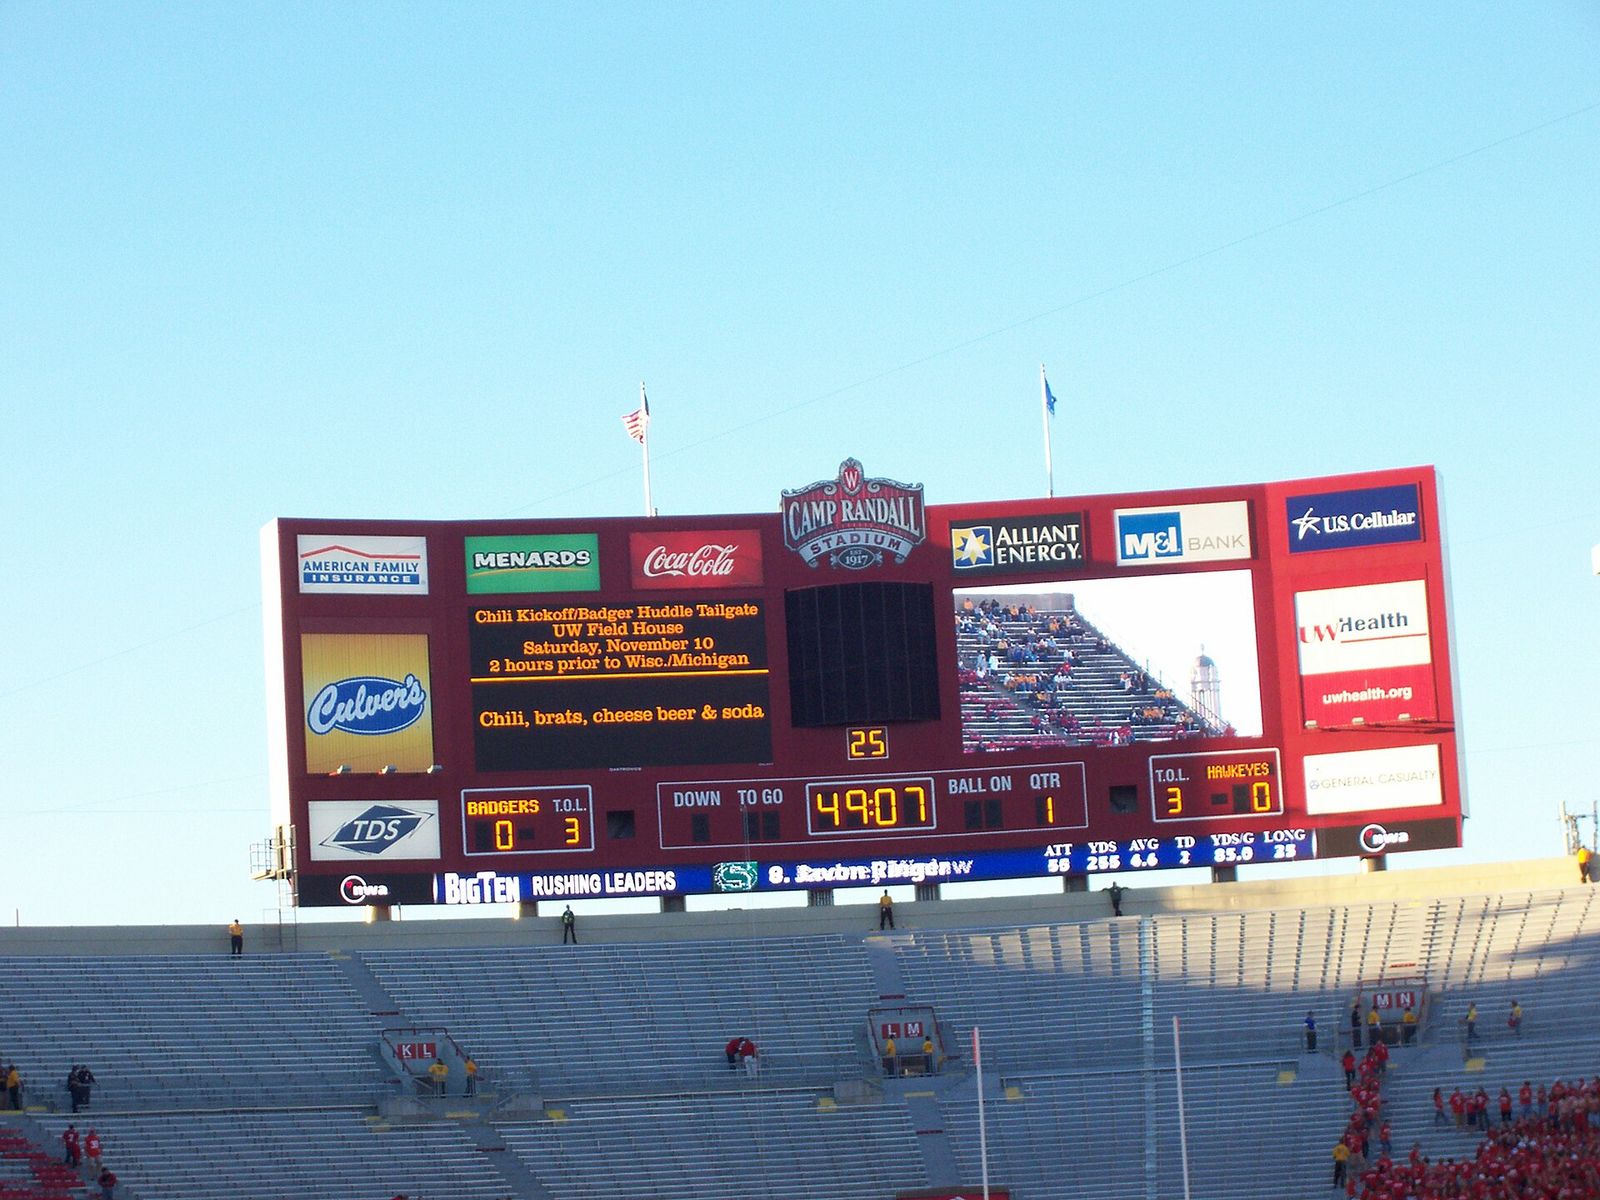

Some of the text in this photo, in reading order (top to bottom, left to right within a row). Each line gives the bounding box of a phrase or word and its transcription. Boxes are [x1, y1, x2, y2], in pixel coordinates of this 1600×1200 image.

[845, 471, 858, 489] W
[788, 496, 920, 541] CAMP RANDALL
[1322, 510, 1416, 533] U.S. Cellular
[810, 533, 902, 555] STADIUM
[995, 524, 1080, 546] ALLIANT
[1188, 533, 1246, 551] BANK
[303, 561, 419, 573] AMERICAN FAMILY
[473, 549, 592, 569] MENARDS
[845, 555, 869, 566] 1917
[312, 574, 412, 583] INSURANCE
[475, 603, 759, 623] Chili Kickoff/Badger Huddle Tailgate
[552, 622, 684, 638] UW Field House
[1300, 612, 1408, 644] UW Health
[523, 637, 714, 656] Saturday, November 10
[489, 652, 750, 674] 2 hours prior to Wisc./Michigan
[308, 674, 426, 735] Culver's
[1322, 686, 1413, 705] uwhealth.org
[479, 704, 765, 728] Chili, brats, cheese beer & soda
[850, 729, 886, 757] 25
[1154, 768, 1190, 783] T.O.L.
[1206, 762, 1270, 780] HAWKEYES
[1321, 769, 1437, 789] GENERAL CASUALTY
[948, 775, 1012, 794] BALL ON
[1030, 773, 1061, 790] QTR
[552, 799, 587, 812] T.O.L.
[673, 790, 721, 807] DOWN
[737, 788, 784, 805] TO GO
[816, 787, 927, 826] 49:07
[1167, 787, 1184, 814] 3
[1252, 781, 1271, 812] 0
[467, 799, 540, 816] BADGERS
[1046, 796, 1054, 824] 1
[352, 819, 401, 841] TDS
[495, 820, 514, 850] 0
[564, 817, 580, 844] 3
[1044, 829, 1306, 857] ATT YDS AVG TD YDS/G LONG
[532, 871, 677, 897] RUSHING LEADERS
[1376, 992, 1410, 1006] M N
[887, 1023, 920, 1036] L M
[402, 1043, 432, 1056] K L
